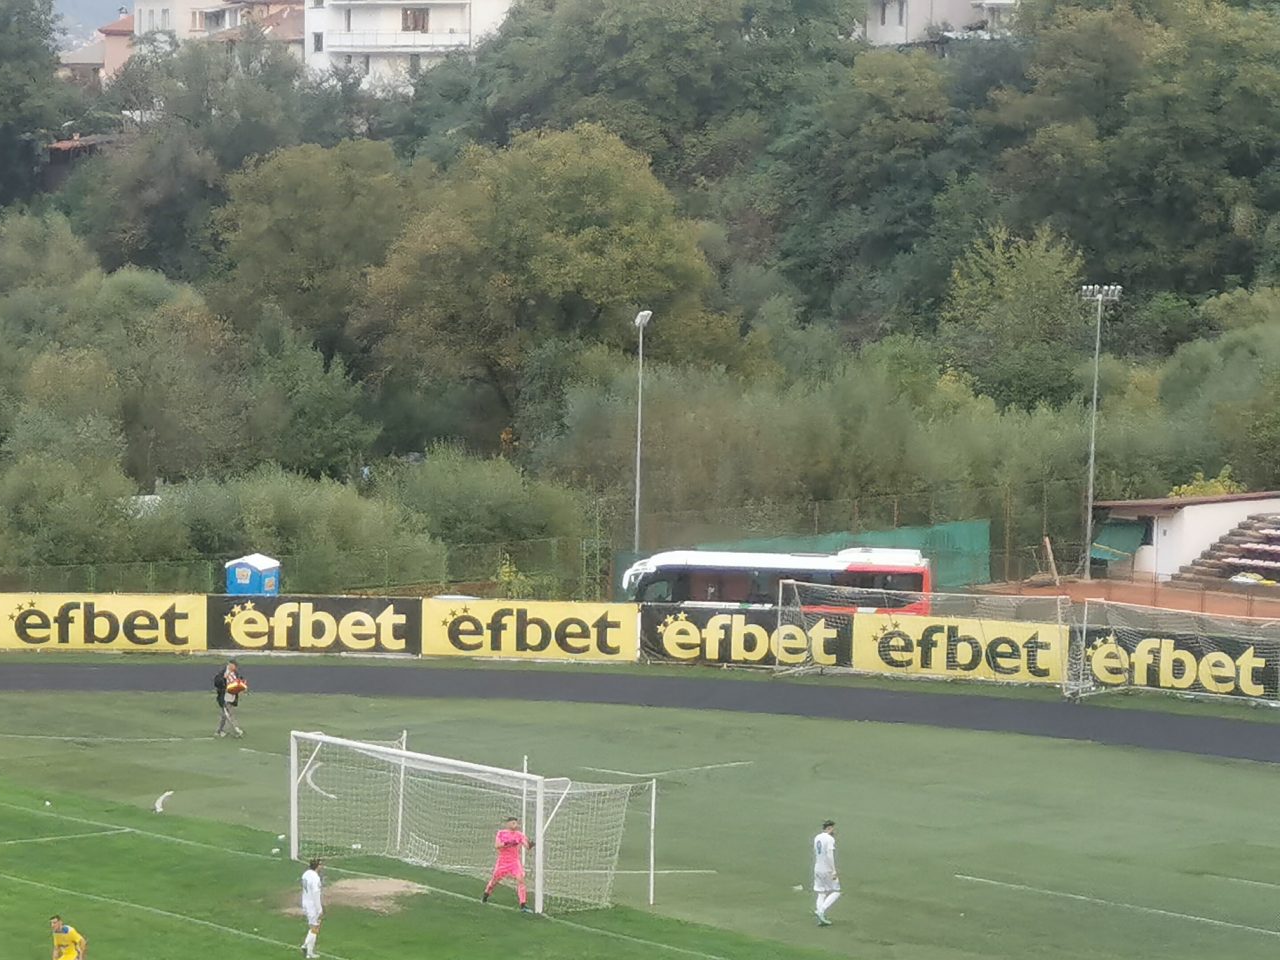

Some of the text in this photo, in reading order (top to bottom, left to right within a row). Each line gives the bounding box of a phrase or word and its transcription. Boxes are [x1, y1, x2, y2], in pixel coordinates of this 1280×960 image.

[14, 602, 190, 646] efbet
[230, 602, 407, 650] efbet
[447, 607, 621, 655] efbet
[662, 614, 838, 666] efbet
[877, 624, 1052, 677] efbet
[1090, 638, 1266, 697] efbet
